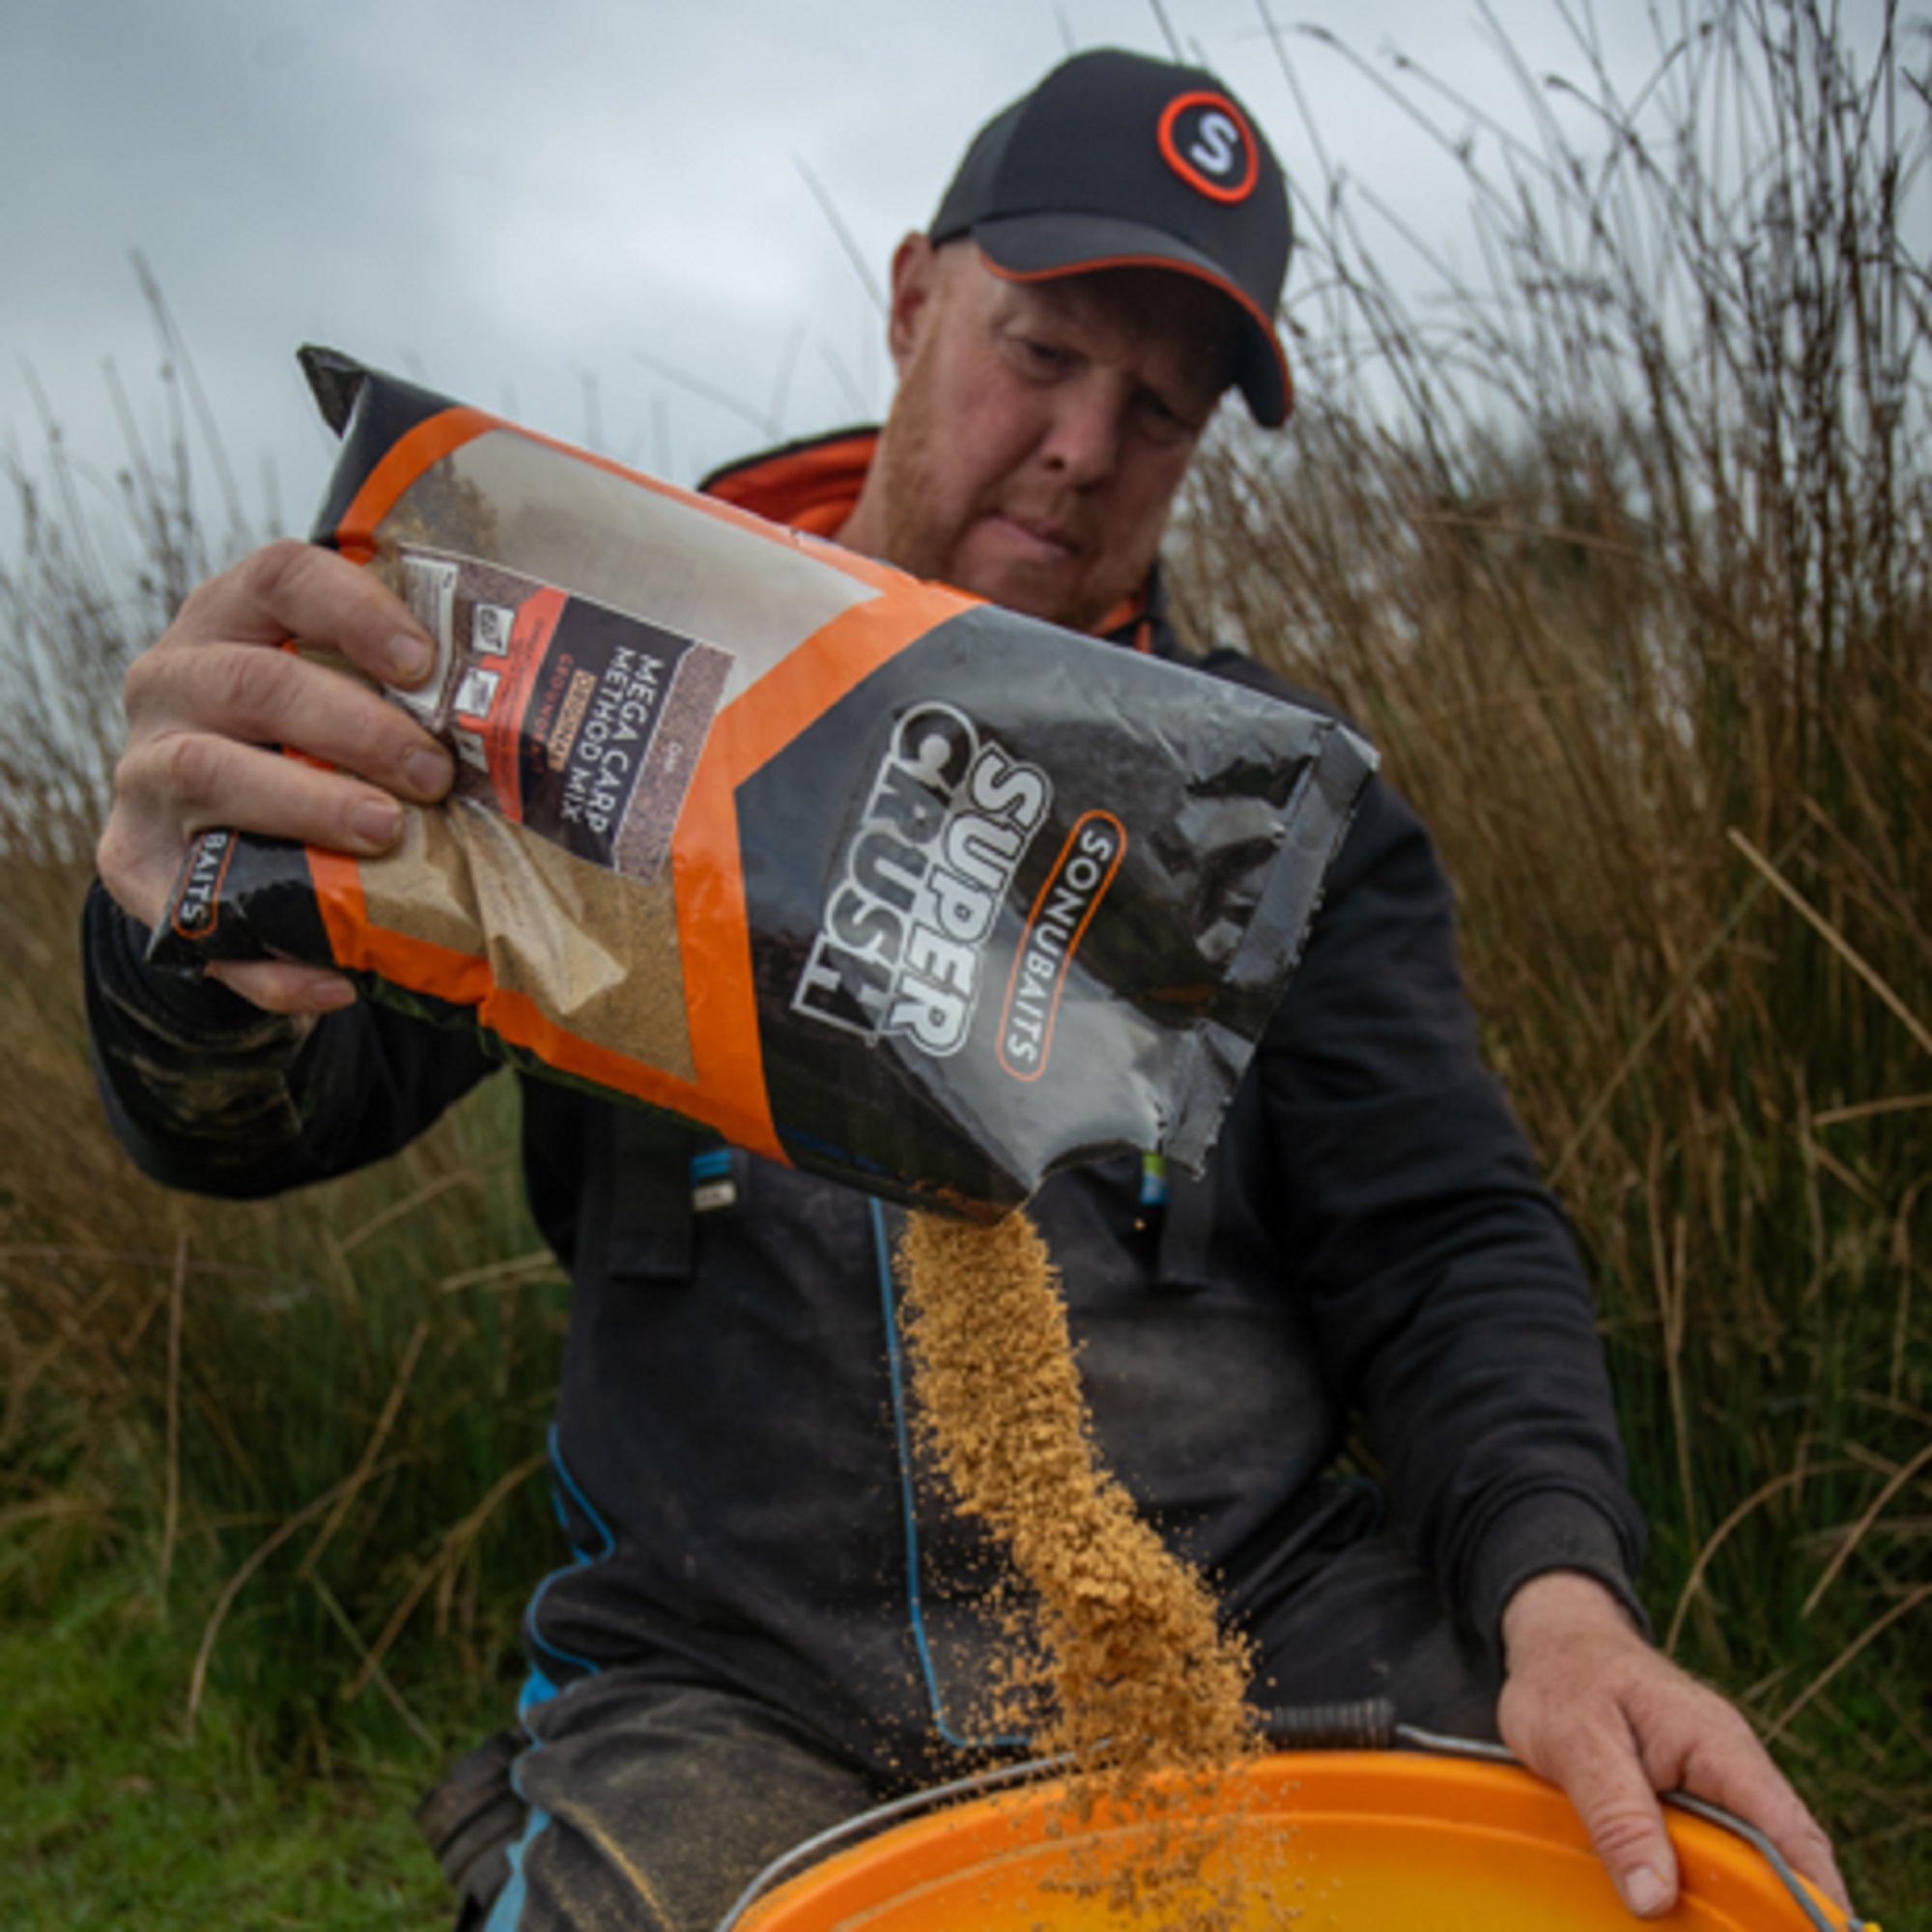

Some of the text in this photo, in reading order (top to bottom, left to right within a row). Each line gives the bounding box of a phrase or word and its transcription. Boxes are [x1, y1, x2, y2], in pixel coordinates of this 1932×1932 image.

[1190, 110, 1238, 175] S
[560, 645, 636, 823] METHOD MIX
[589, 654, 665, 833] MEGA CARP
[181, 832, 228, 922] BAITS
[790, 701, 980, 1047] CRUSH
[889, 748, 1049, 1053] SUPER
[1008, 829, 1114, 1065] SONUBAITS
